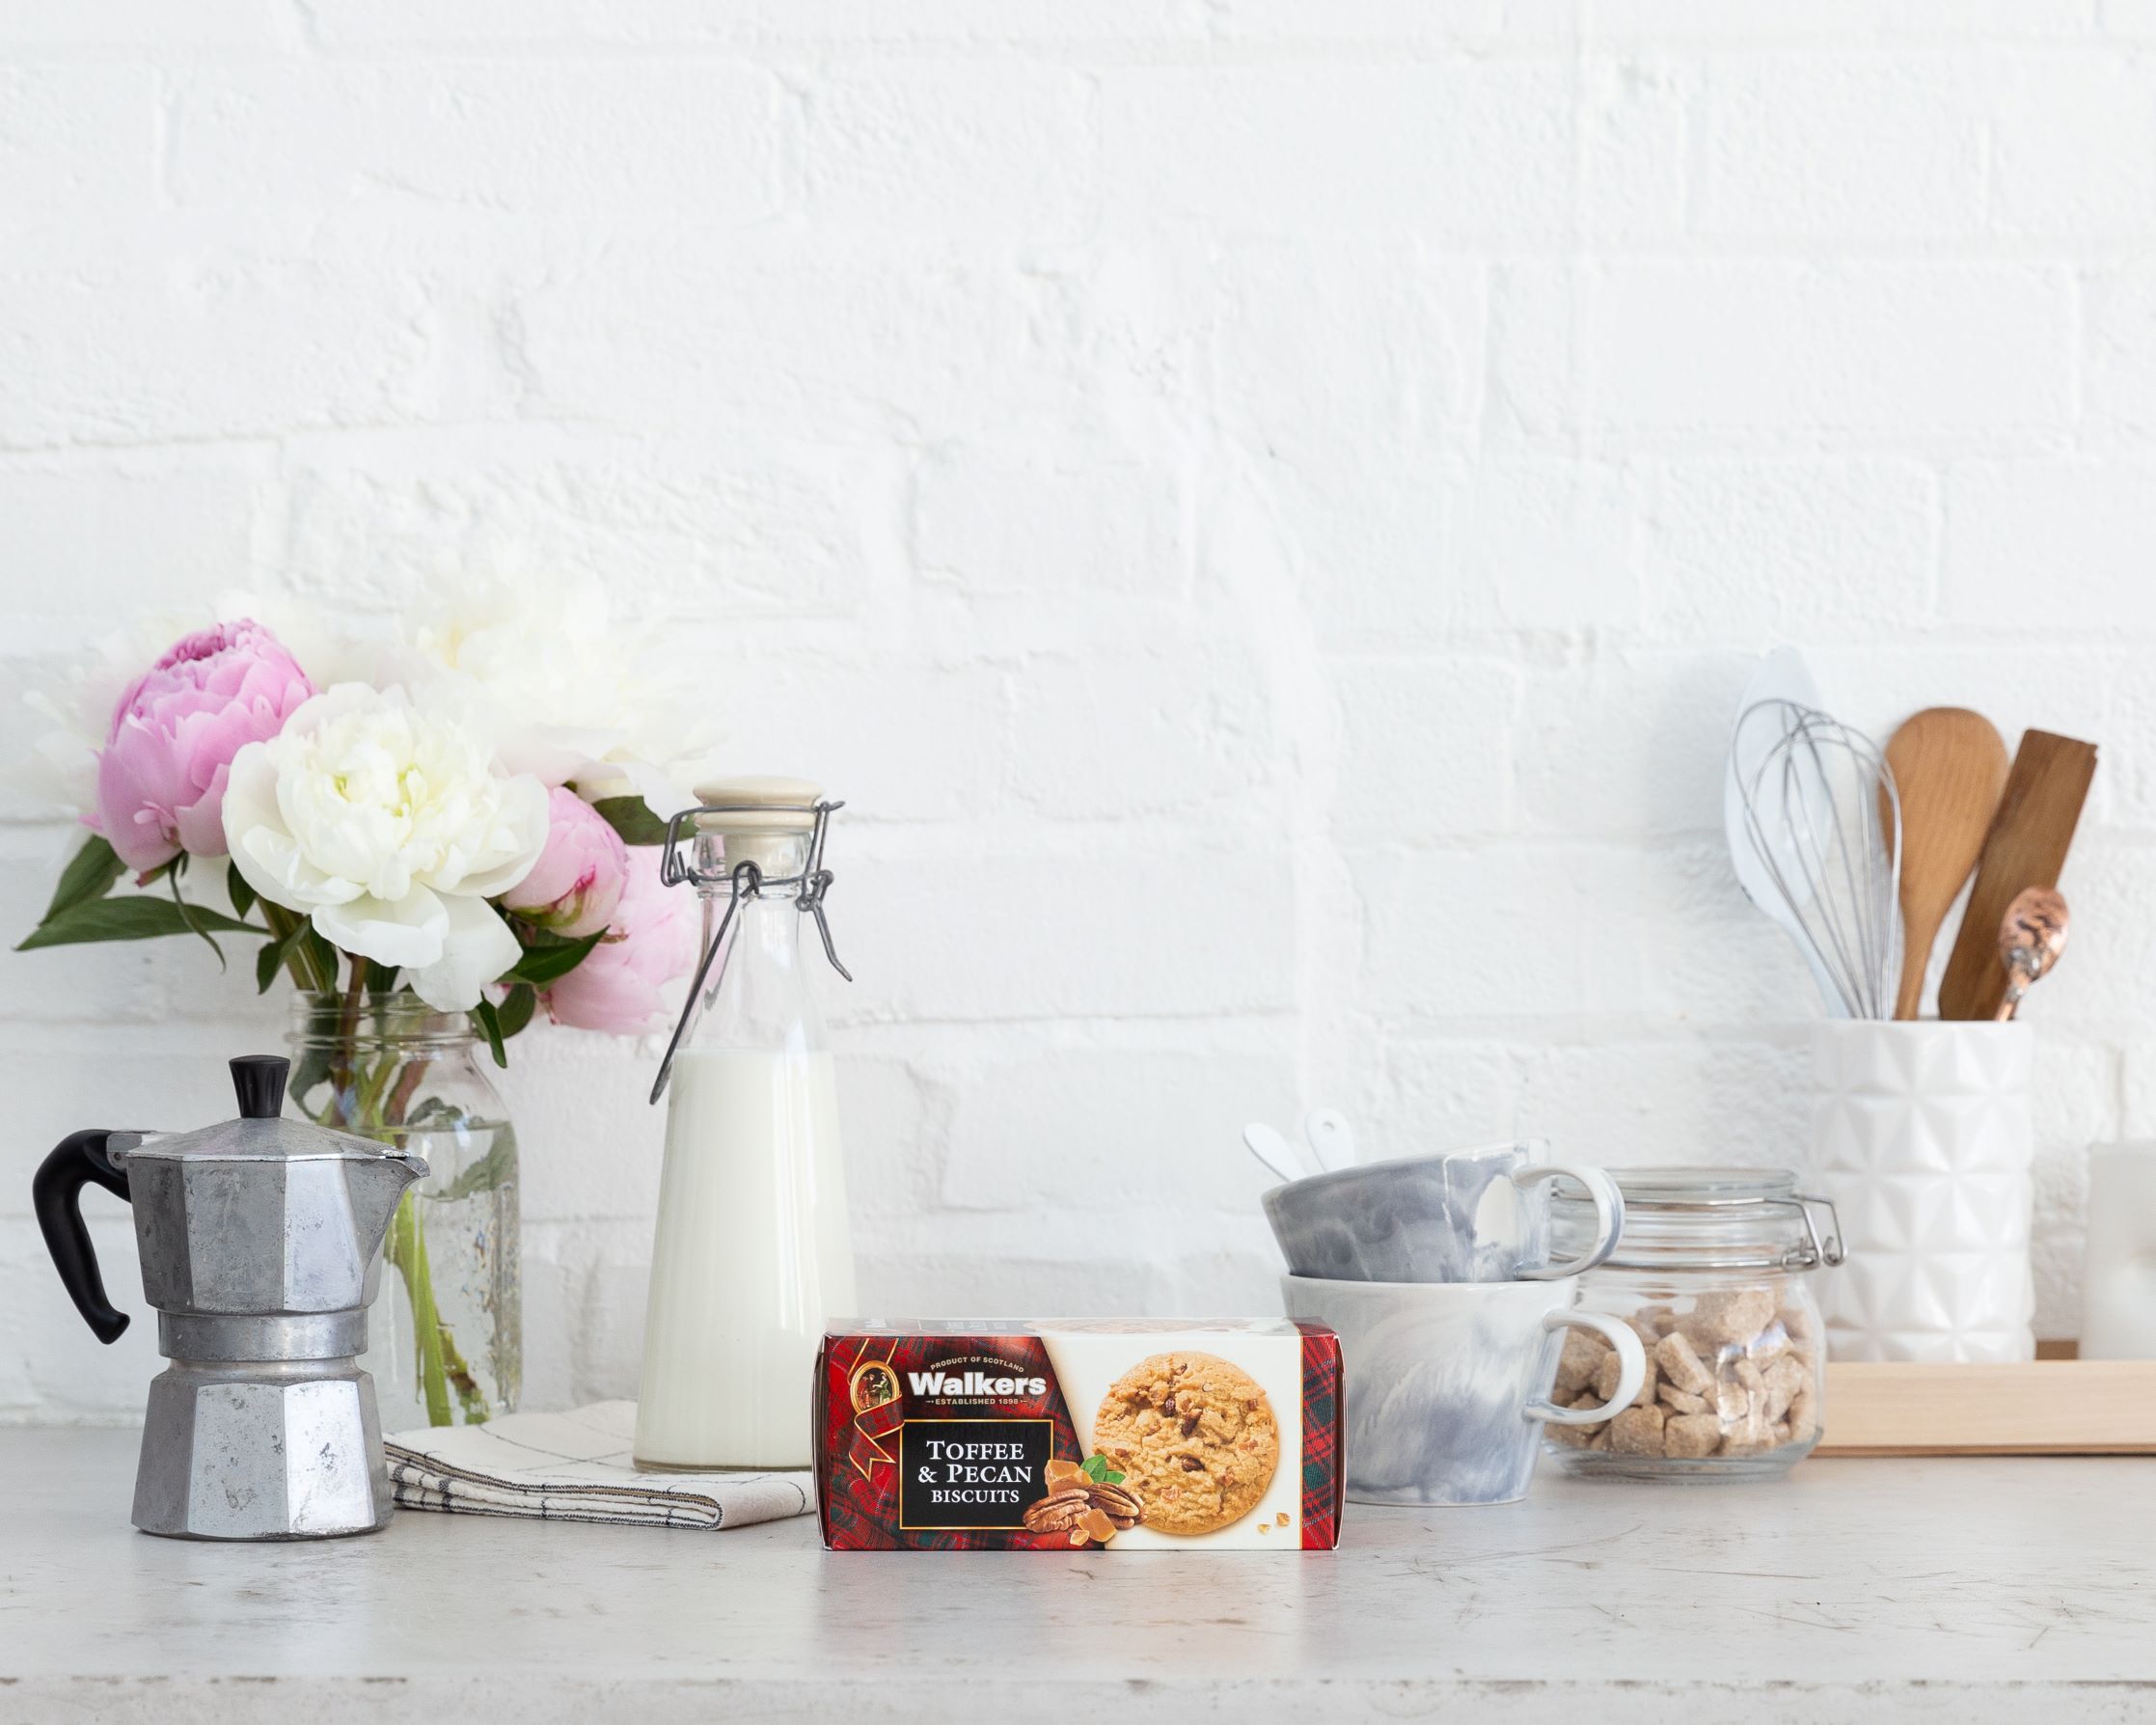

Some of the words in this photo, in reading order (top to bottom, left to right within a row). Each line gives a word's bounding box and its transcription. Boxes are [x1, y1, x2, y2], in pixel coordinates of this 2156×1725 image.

[930, 1356, 968, 1370] PRODUCT
[982, 1356, 1024, 1372] SCOTLAND
[907, 1372, 1047, 1396] Walkers
[926, 1440, 1024, 1460] TOFFEE
[917, 1465, 938, 1484] &
[946, 1464, 1032, 1484] PECAN
[931, 1490, 1020, 1503] BISCUITS
